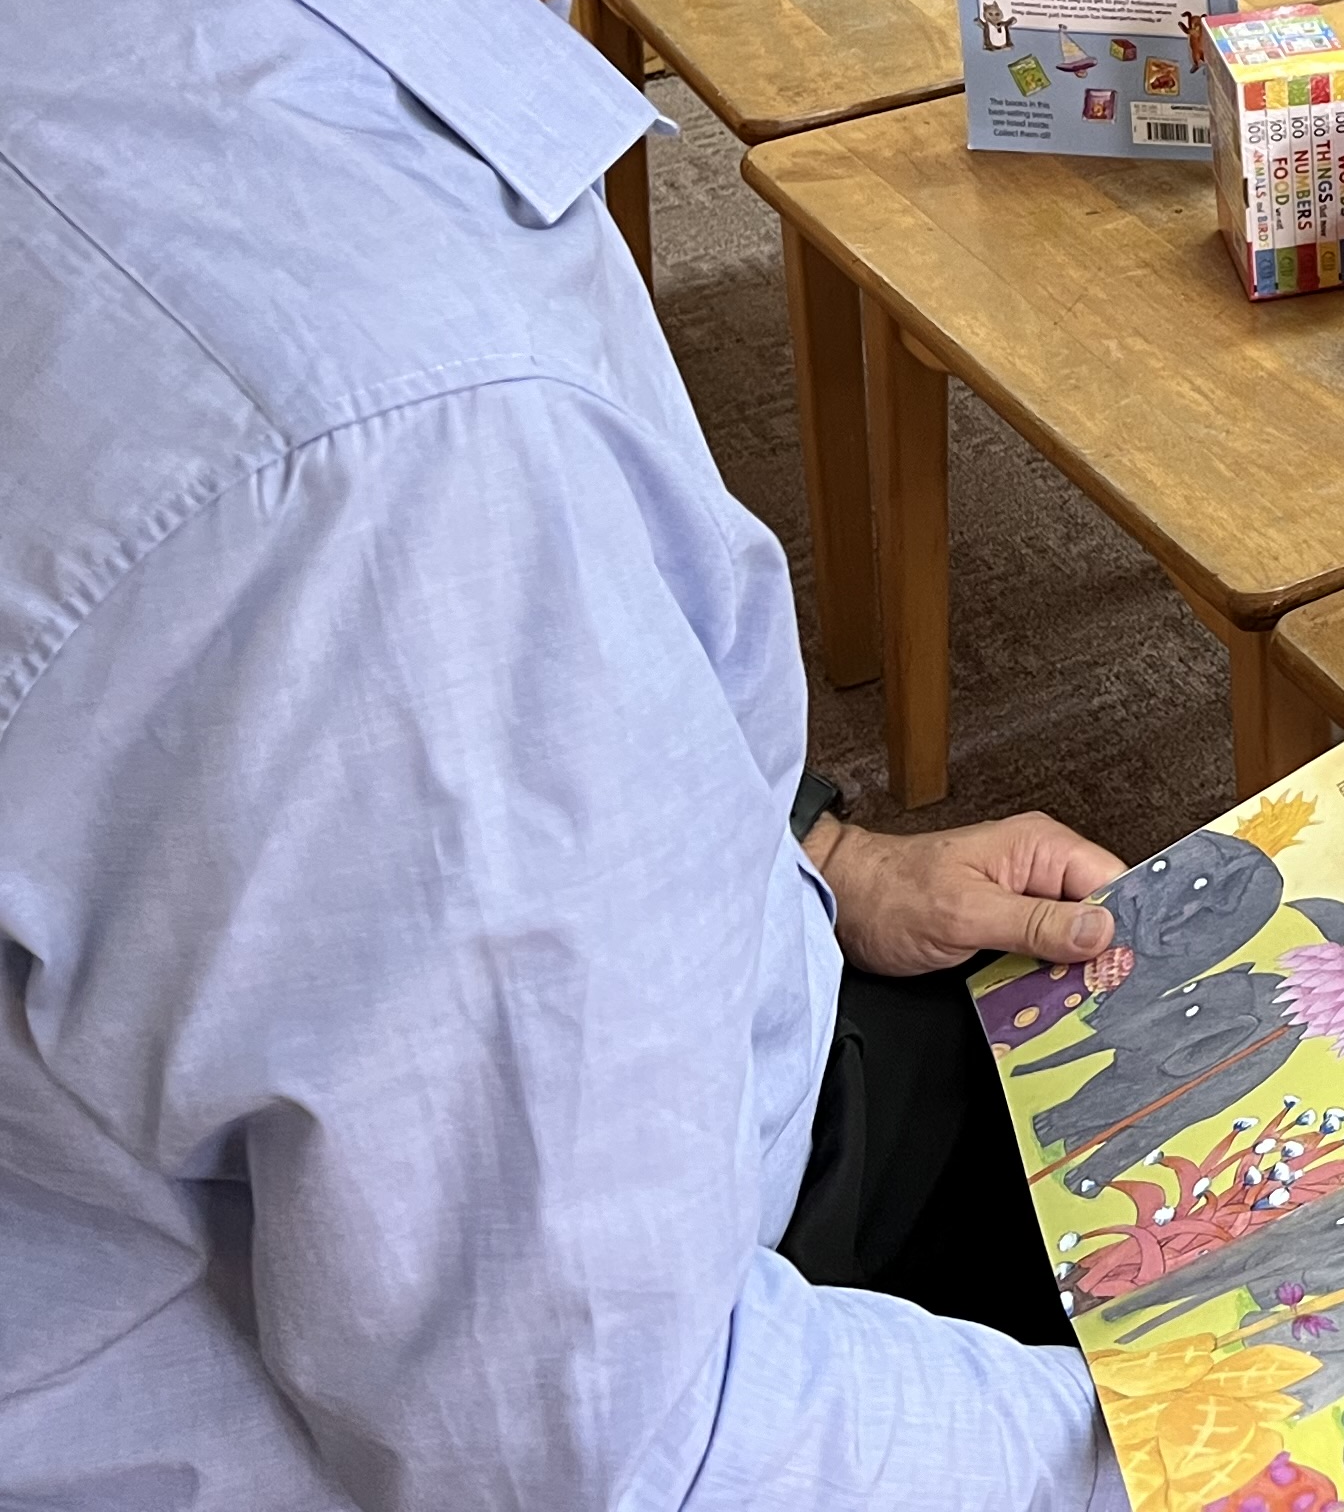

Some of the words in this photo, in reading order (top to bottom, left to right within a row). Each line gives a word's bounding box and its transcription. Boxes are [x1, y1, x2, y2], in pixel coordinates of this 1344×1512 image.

[1247, 122, 1262, 144] 100
[1268, 119, 1283, 142] 100
[1290, 116, 1305, 139] 100
[1311, 114, 1326, 137] 100
[1250, 149, 1268, 198] ANIMALS
[1270, 156, 1292, 205] FOOD
[1311, 140, 1337, 203] THINGS
[1288, 149, 1317, 230] NUMBERS
[1256, 215, 1271, 248] BIRDS
